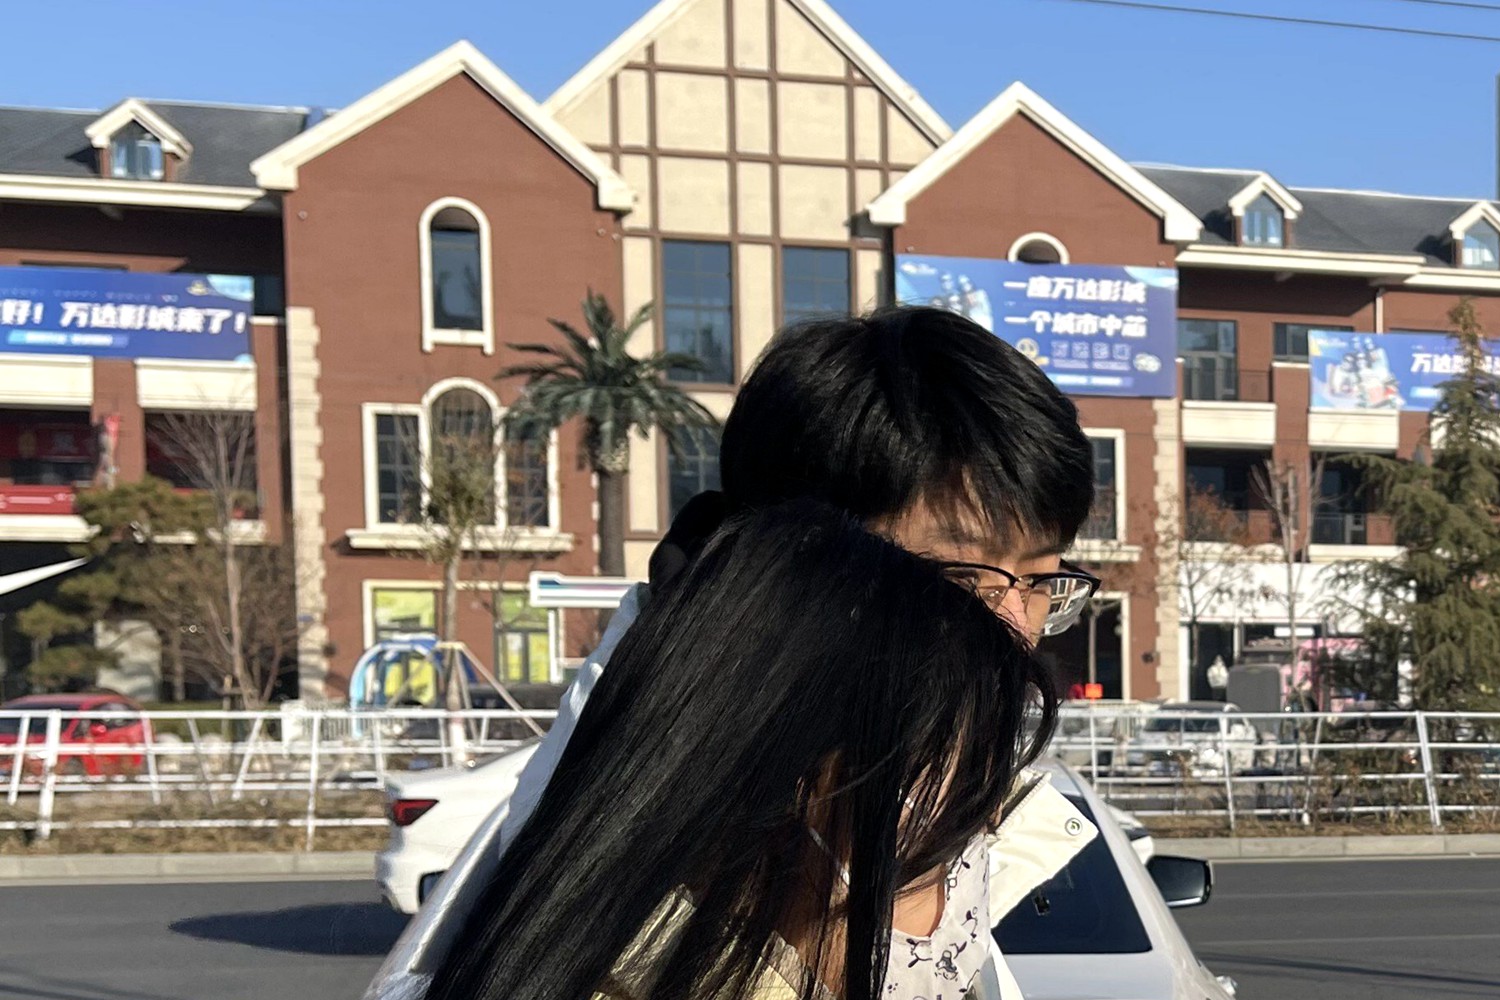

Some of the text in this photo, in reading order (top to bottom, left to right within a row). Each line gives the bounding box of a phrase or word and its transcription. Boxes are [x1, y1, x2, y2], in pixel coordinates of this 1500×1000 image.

[1003, 275, 1147, 304] 一座万达影城
